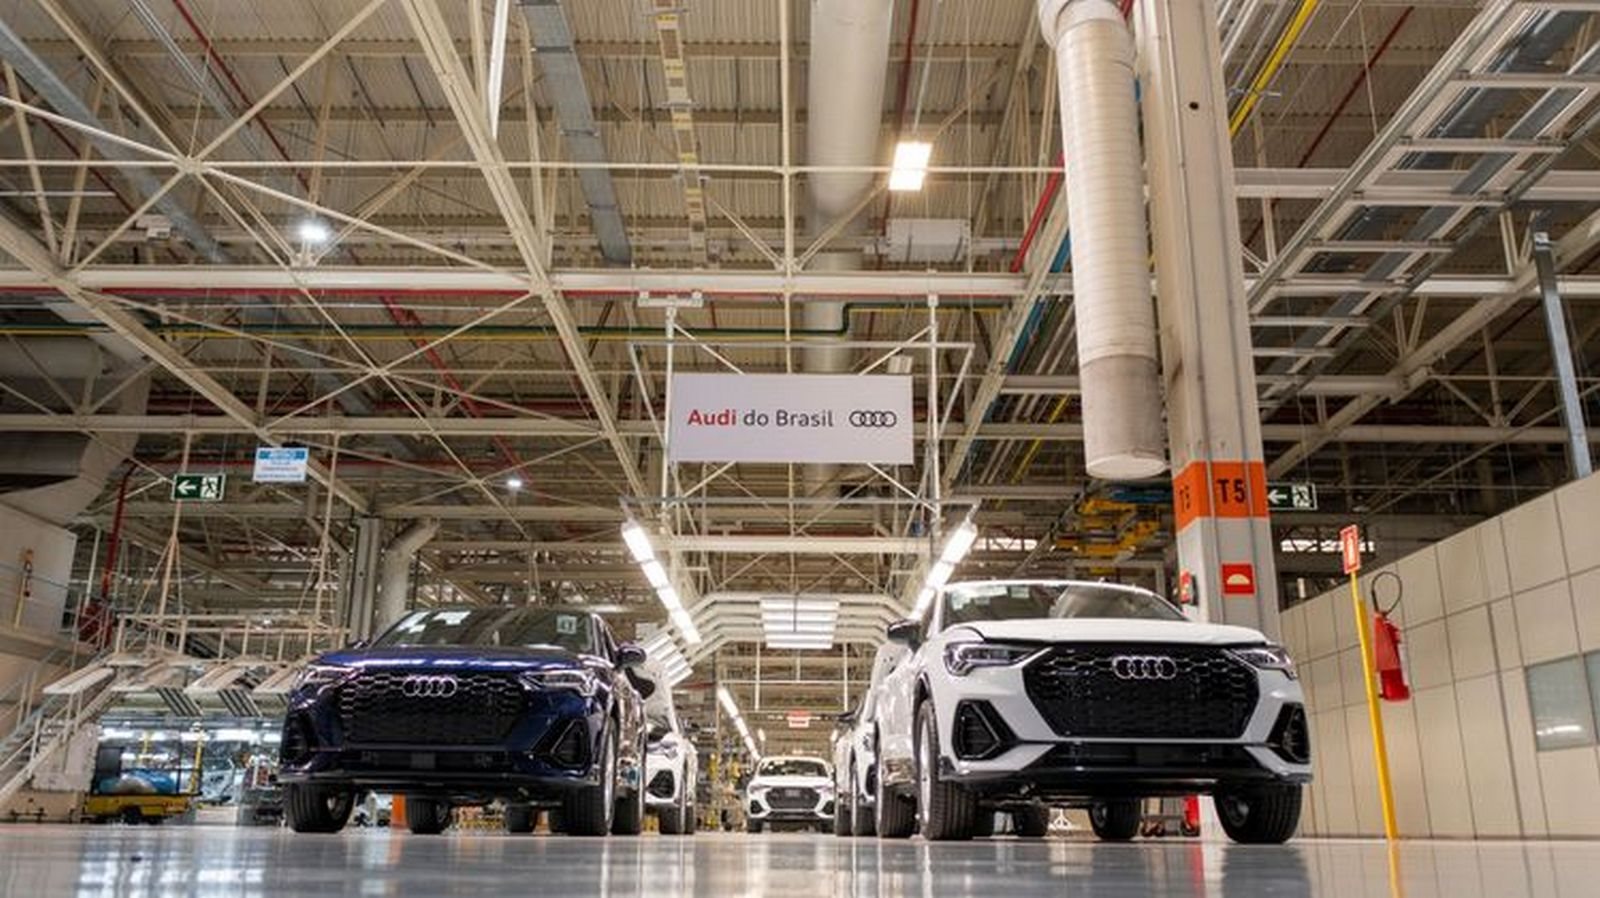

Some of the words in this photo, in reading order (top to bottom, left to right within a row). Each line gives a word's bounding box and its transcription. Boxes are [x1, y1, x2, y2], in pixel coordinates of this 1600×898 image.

[687, 409, 737, 427] Audi
[743, 409, 770, 427] do
[775, 409, 834, 428] Brasil
[1216, 478, 1246, 503] T5
